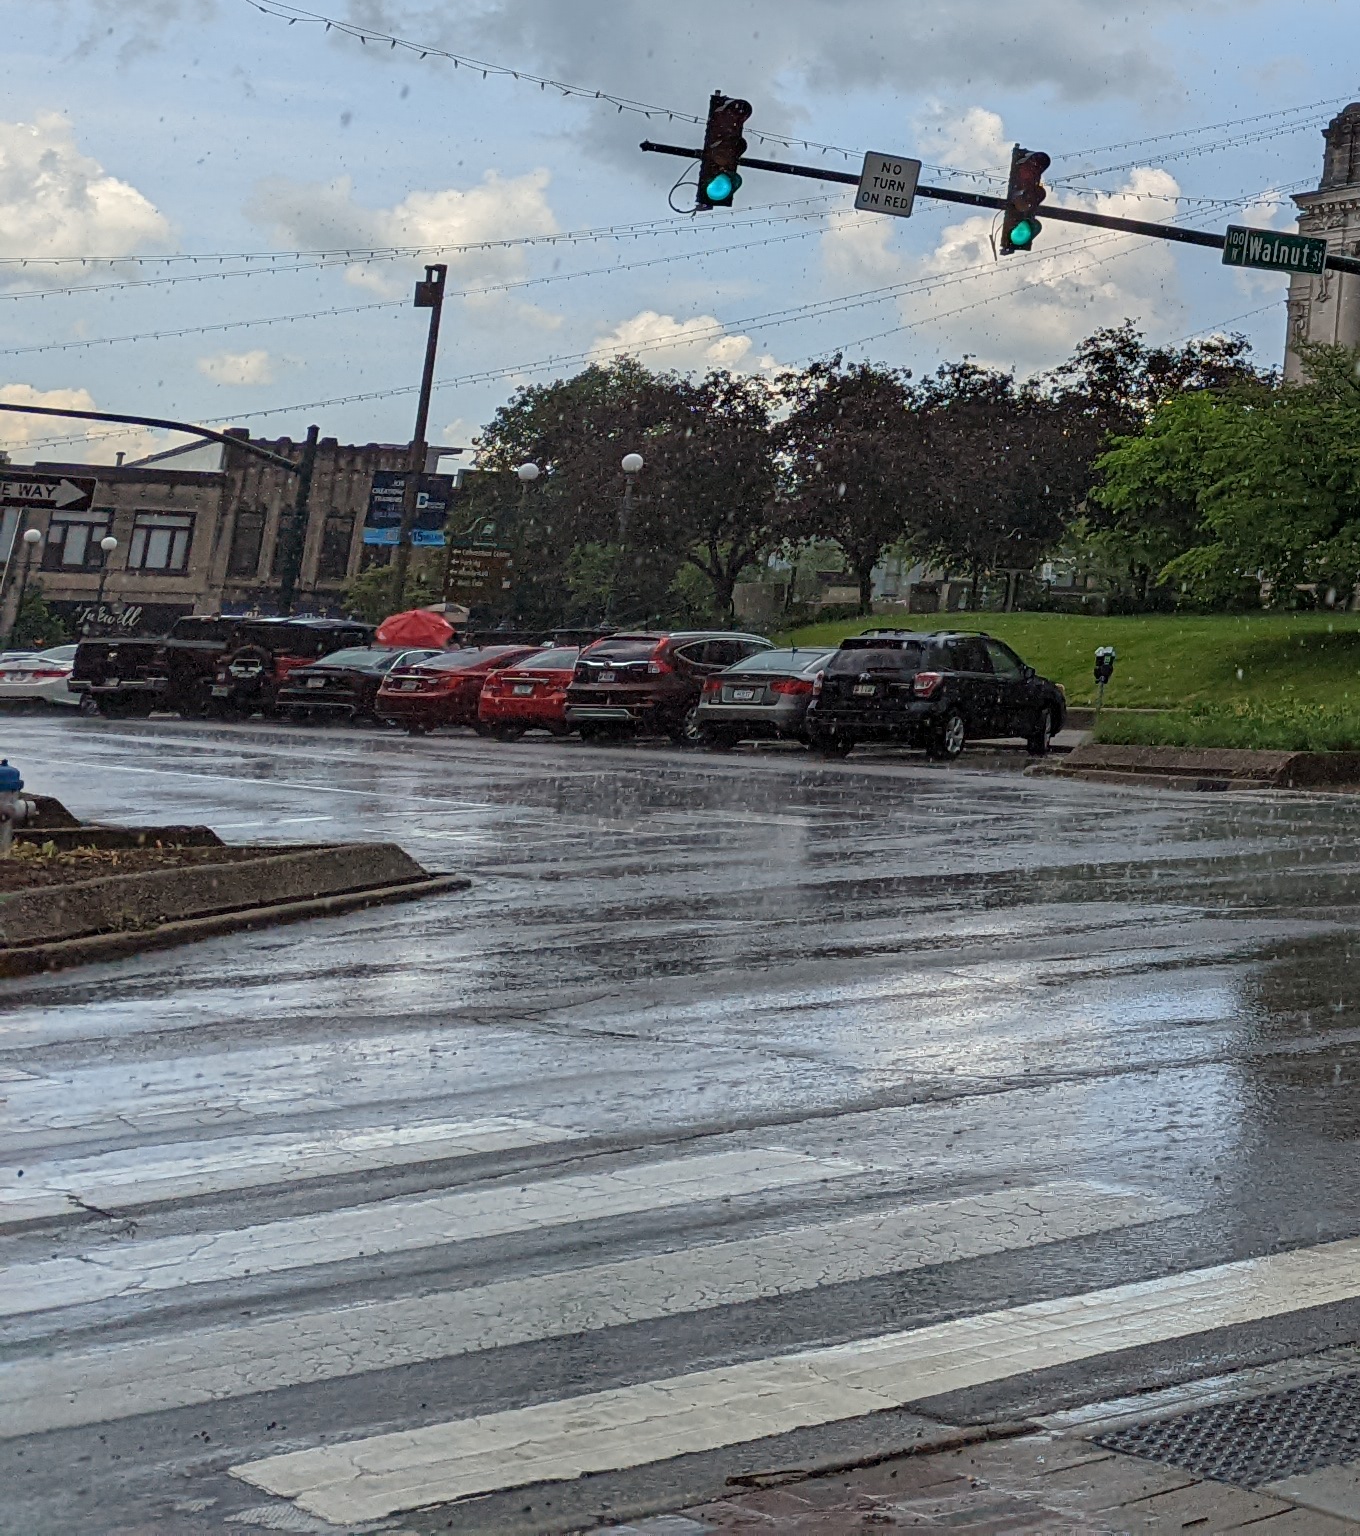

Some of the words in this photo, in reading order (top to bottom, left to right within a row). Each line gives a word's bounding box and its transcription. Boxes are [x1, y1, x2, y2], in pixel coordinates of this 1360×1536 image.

[881, 161, 902, 176] NO
[873, 176, 906, 193] TURN
[862, 191, 880, 205] ON
[884, 194, 909, 210] RED
[1229, 230, 1246, 245] 100
[1248, 235, 1310, 267] Walnut
[19, 483, 56, 499] WAY
